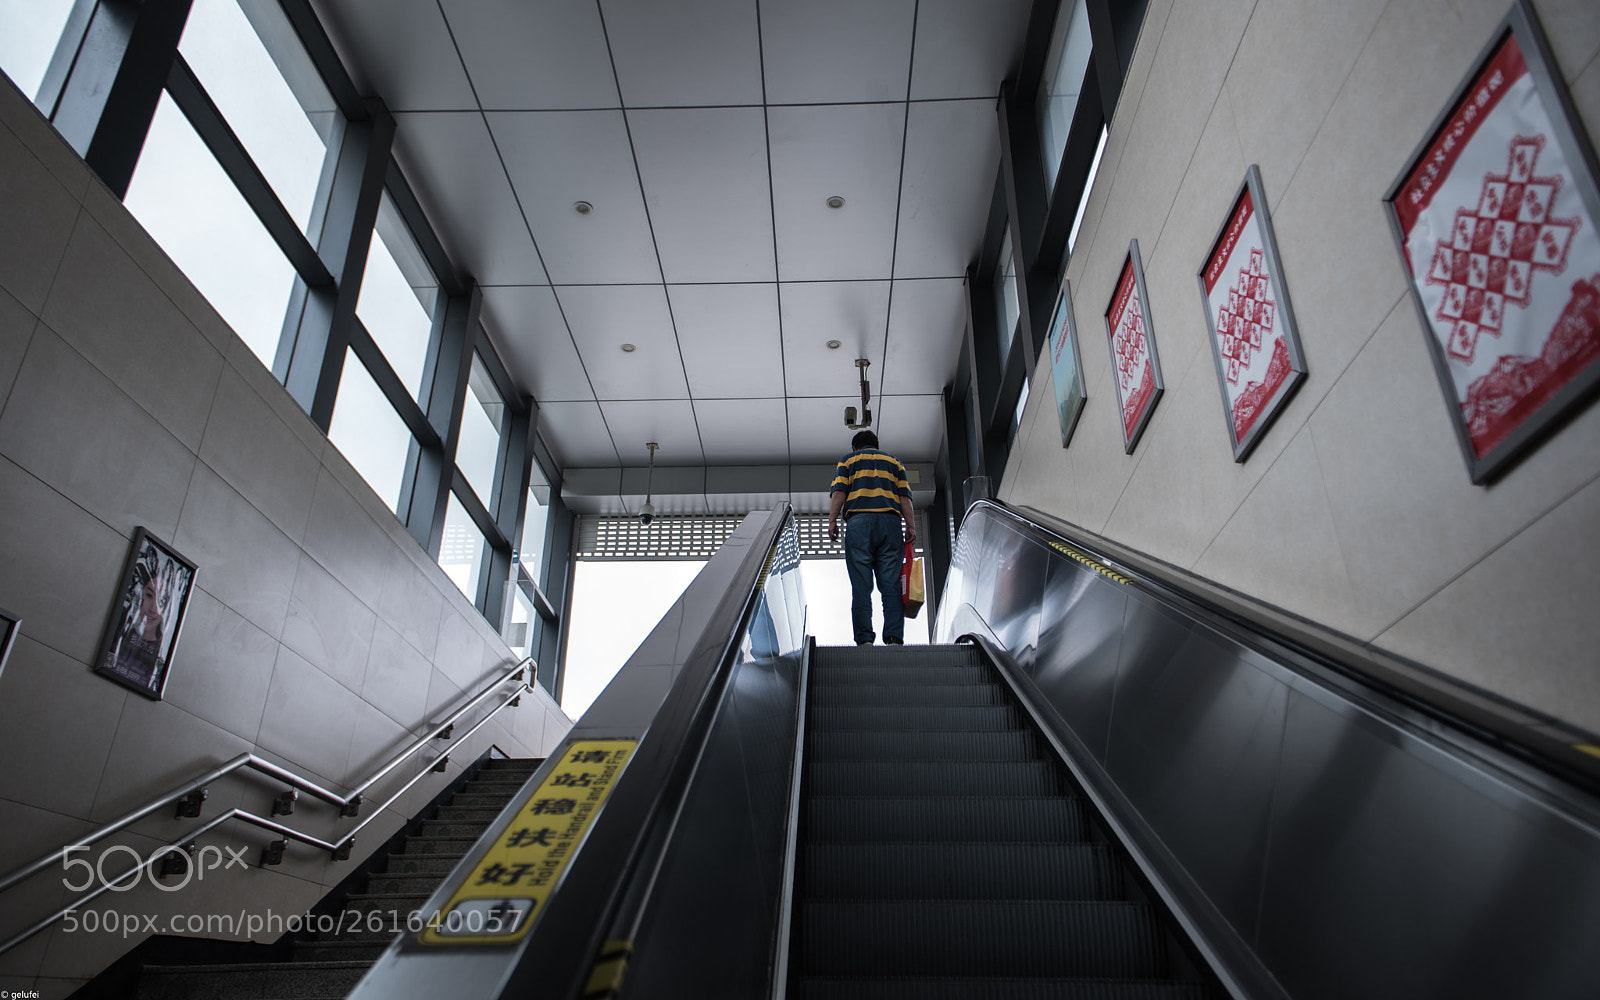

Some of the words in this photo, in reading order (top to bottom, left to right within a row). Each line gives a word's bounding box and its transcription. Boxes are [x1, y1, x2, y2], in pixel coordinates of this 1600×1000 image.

[606, 749, 628, 765] Firm
[592, 765, 618, 786] Stand
[586, 786, 605, 801] and
[474, 749, 613, 887] 请站稳扶好
[557, 802, 596, 840] Handrail
[527, 860, 560, 887] Hold
